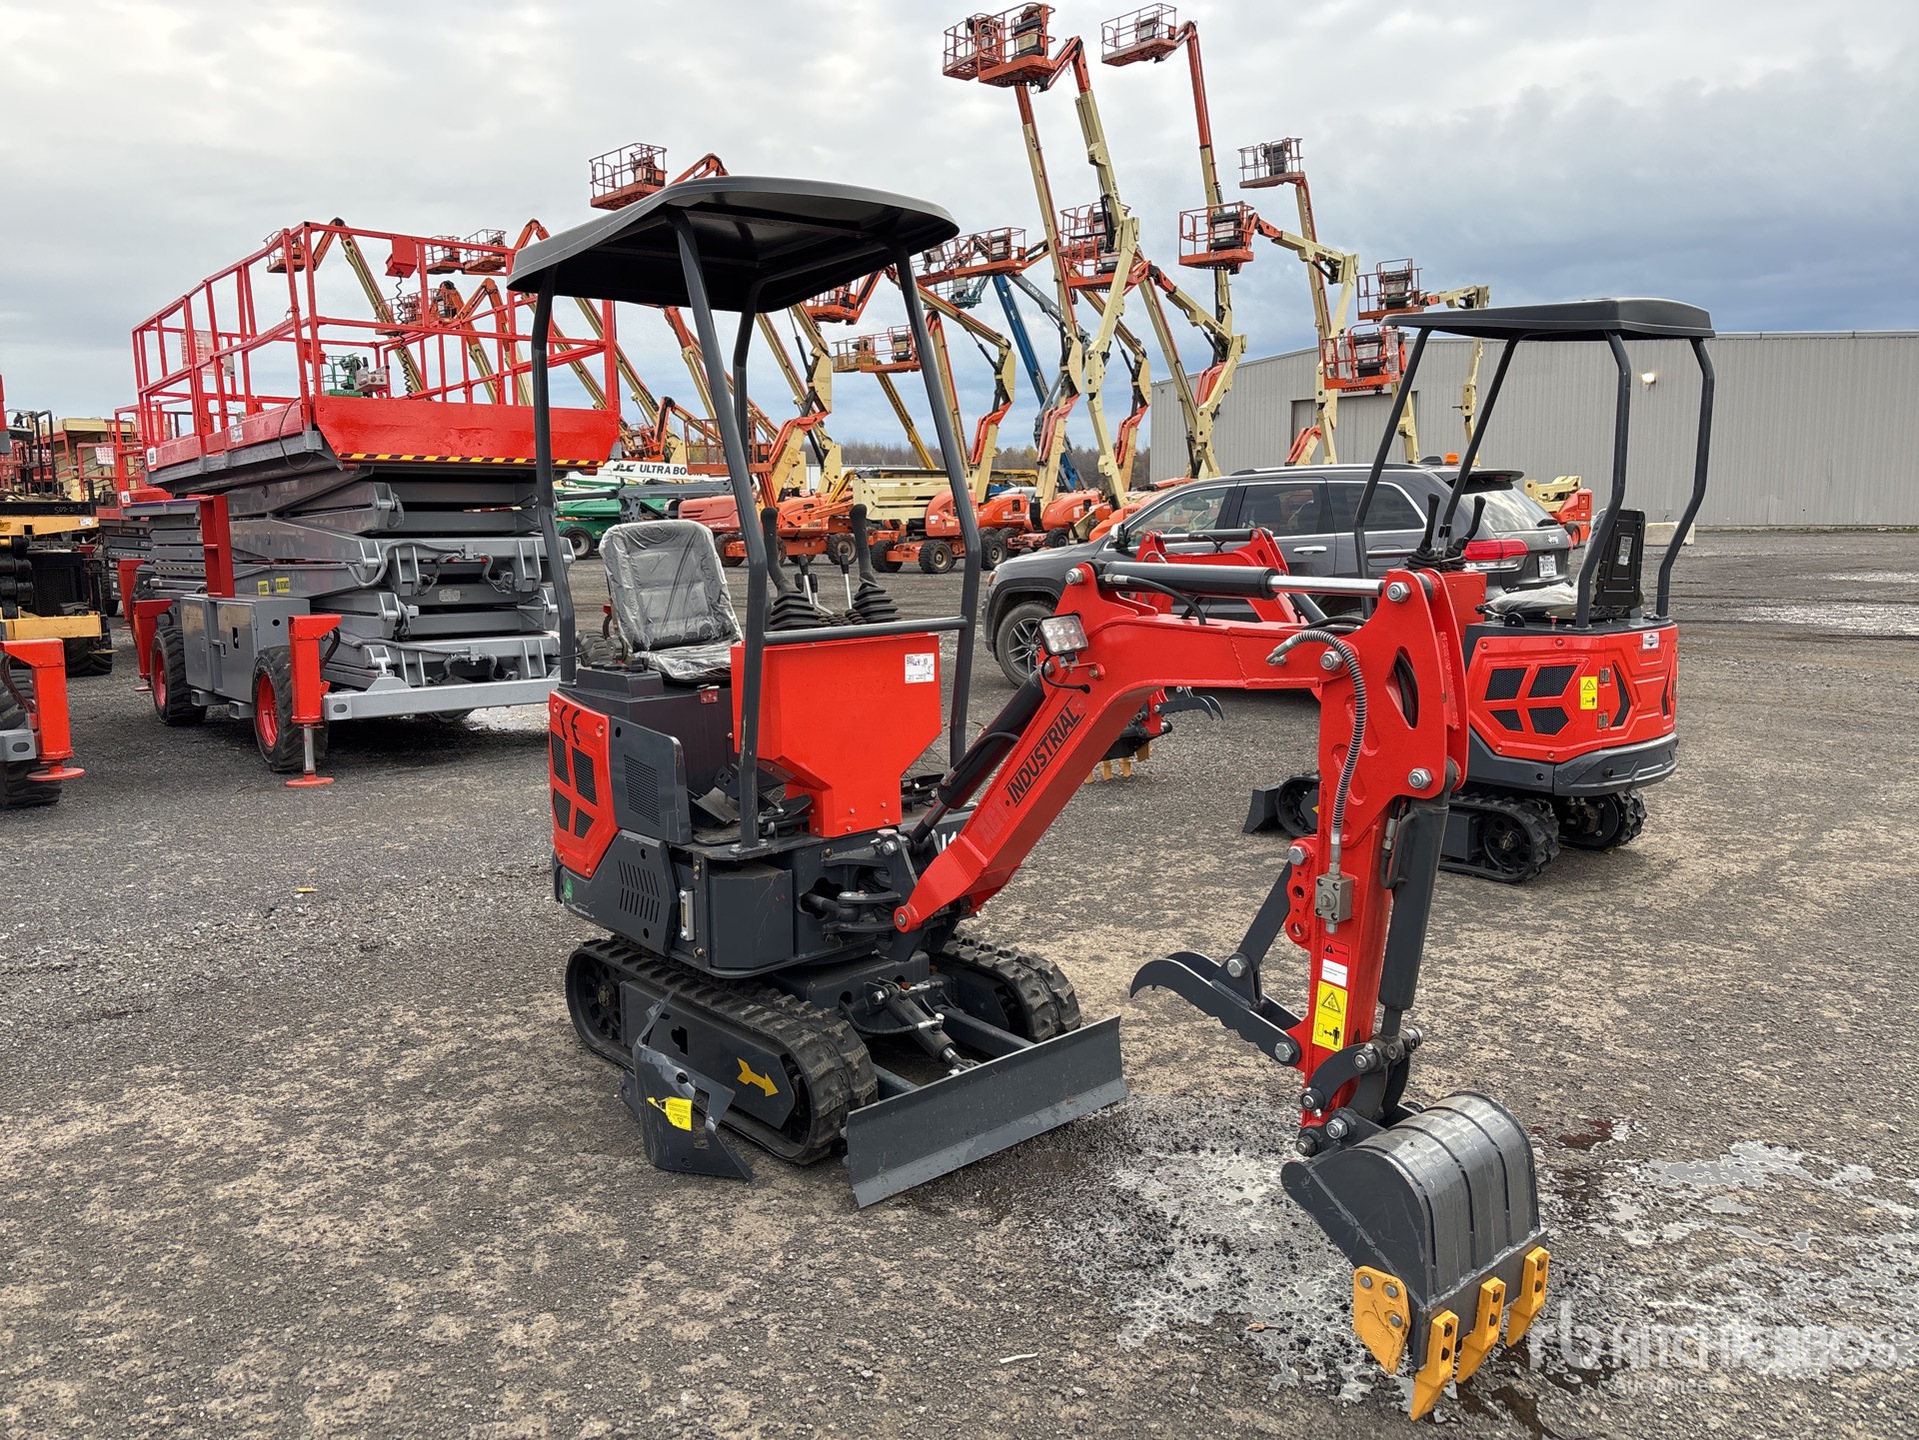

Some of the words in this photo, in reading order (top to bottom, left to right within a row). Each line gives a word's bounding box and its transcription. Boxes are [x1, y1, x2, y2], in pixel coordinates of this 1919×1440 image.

[612, 462, 636, 473] JLG
[639, 463, 671, 475] ULTRA
[672, 465, 703, 477] BO
[1007, 706, 1080, 803] INDUSTRIAL
